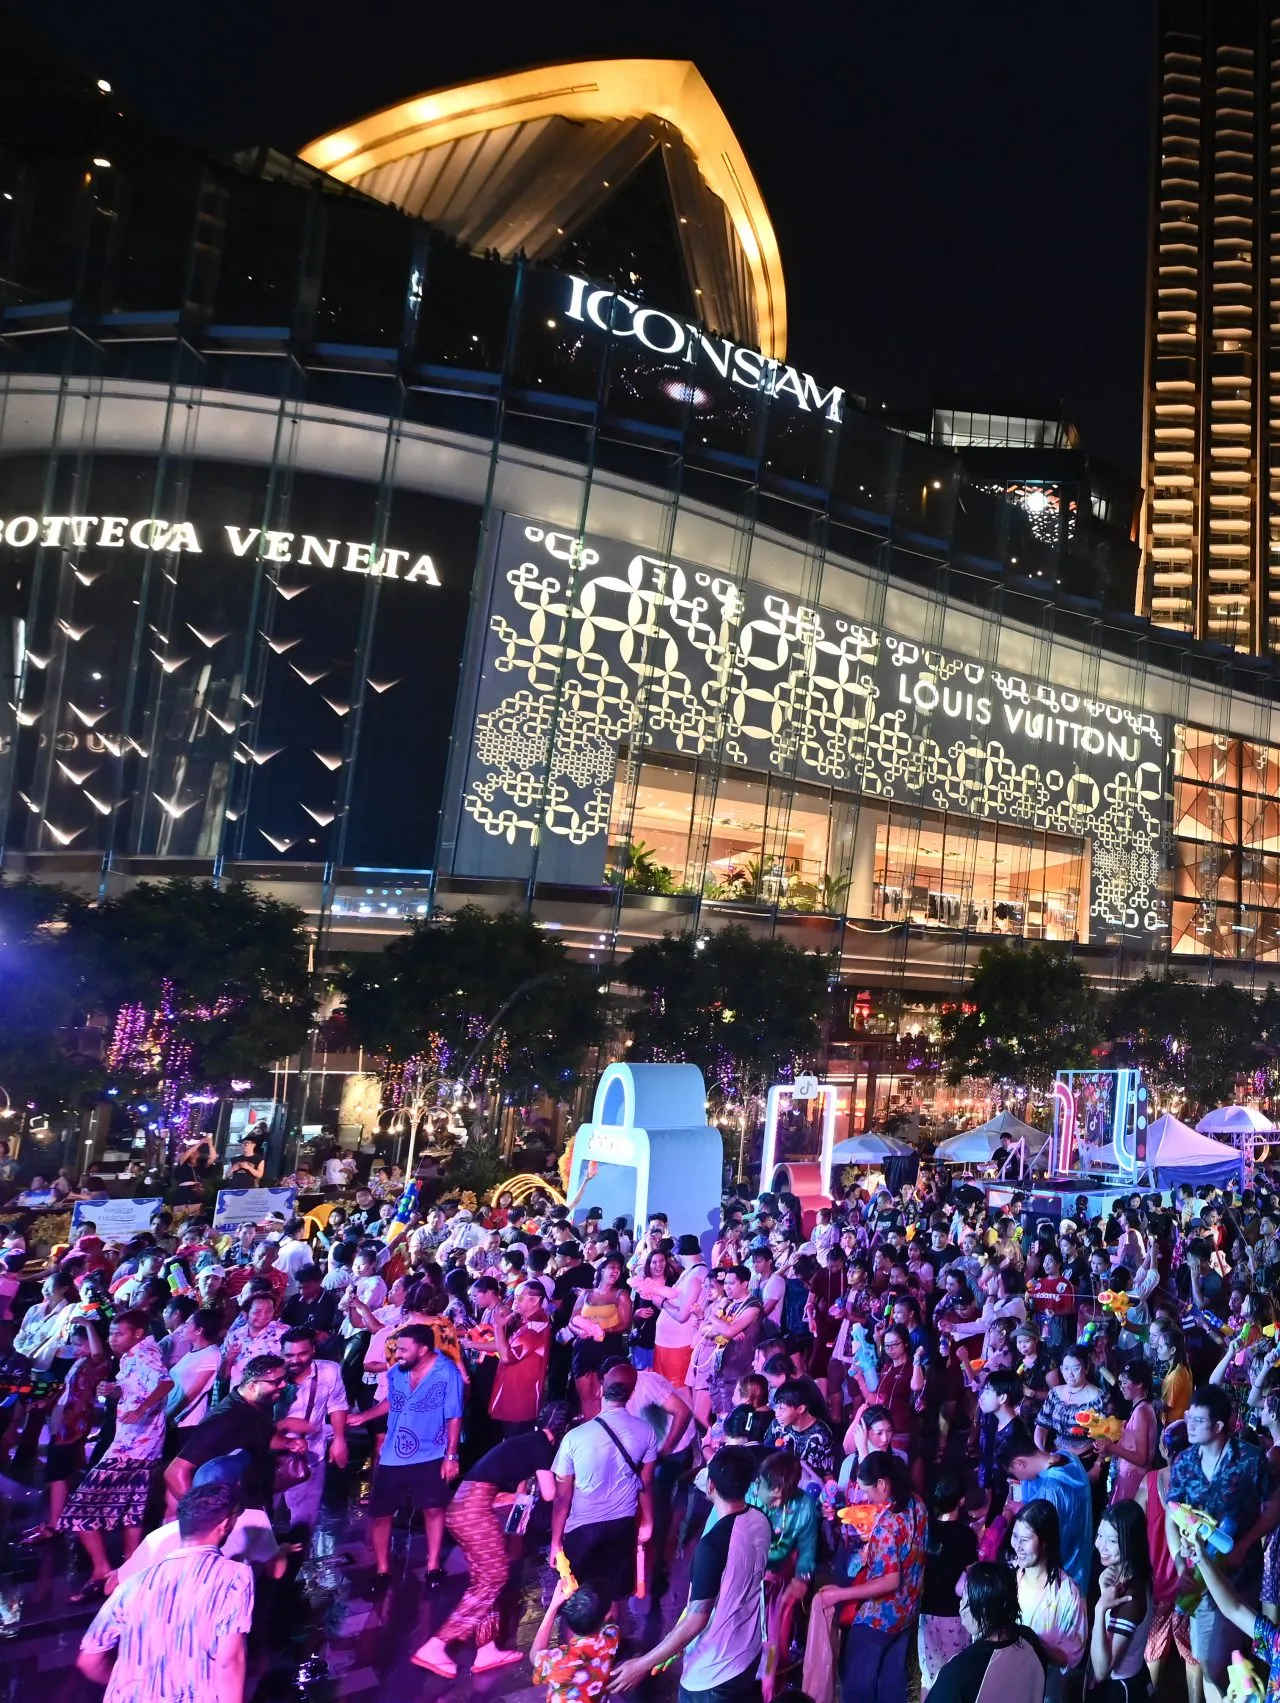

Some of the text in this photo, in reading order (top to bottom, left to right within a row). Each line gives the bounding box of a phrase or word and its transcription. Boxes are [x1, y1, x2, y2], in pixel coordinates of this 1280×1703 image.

[565, 275, 846, 423] ICONSIAM
[0, 515, 442, 587] OTTEGA VENETA
[898, 673, 1130, 762] LOUIS VUITTON
